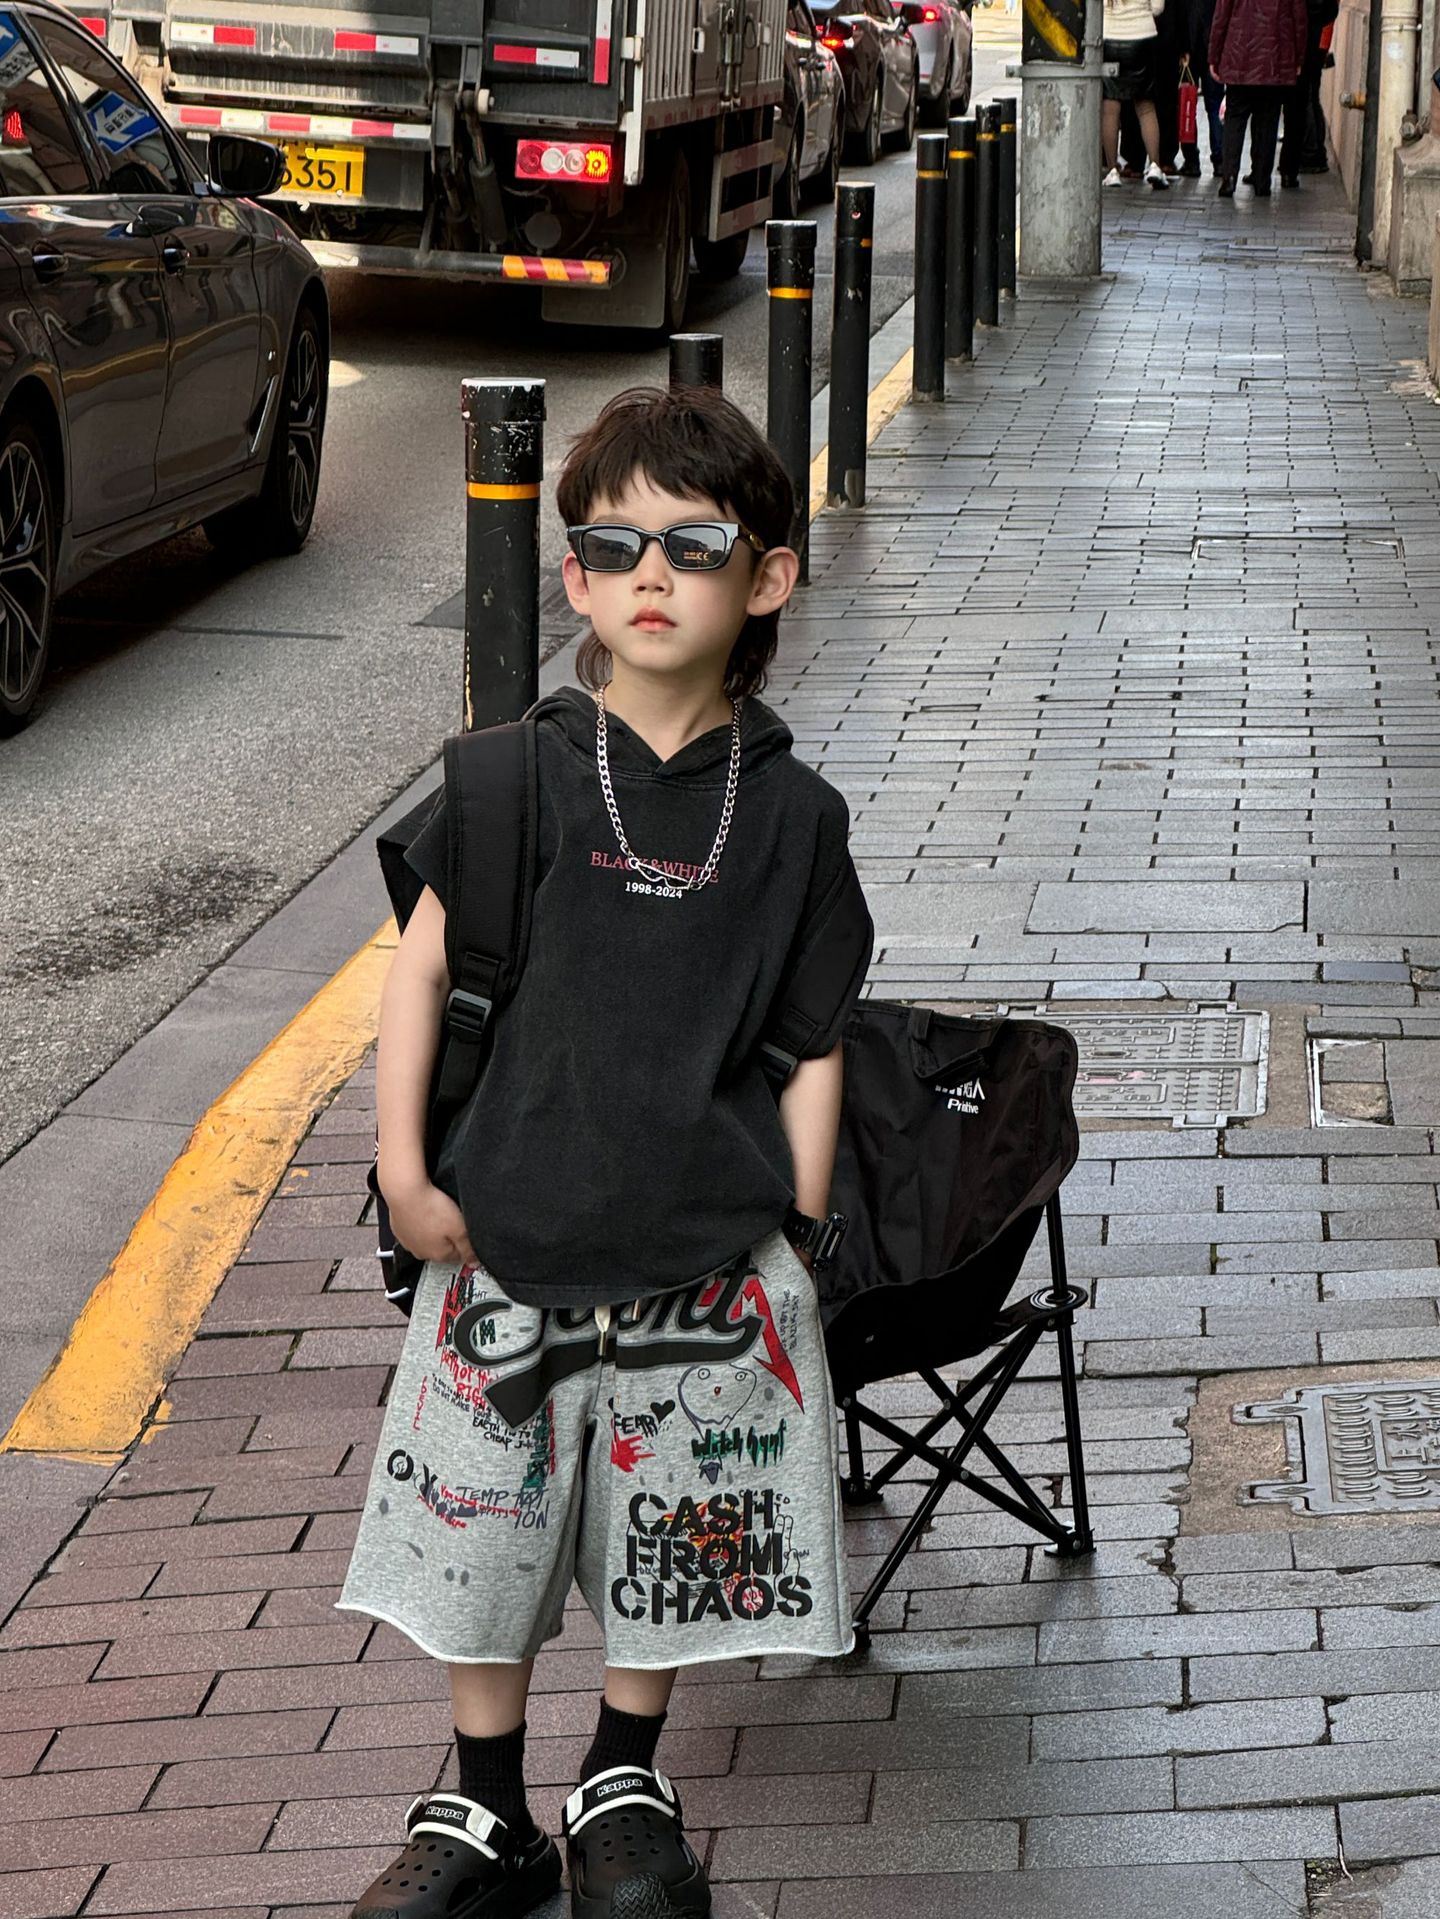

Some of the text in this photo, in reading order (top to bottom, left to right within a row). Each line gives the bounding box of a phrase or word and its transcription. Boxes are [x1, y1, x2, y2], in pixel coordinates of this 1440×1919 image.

[625, 881, 683, 899] 1998-2024
[629, 1489, 774, 1537] CASH
[626, 1532, 783, 1581] FROM
[611, 1575, 813, 1625] CHAOS
[597, 1778, 643, 1798] Kappa
[424, 1805, 465, 1821] Kappa
